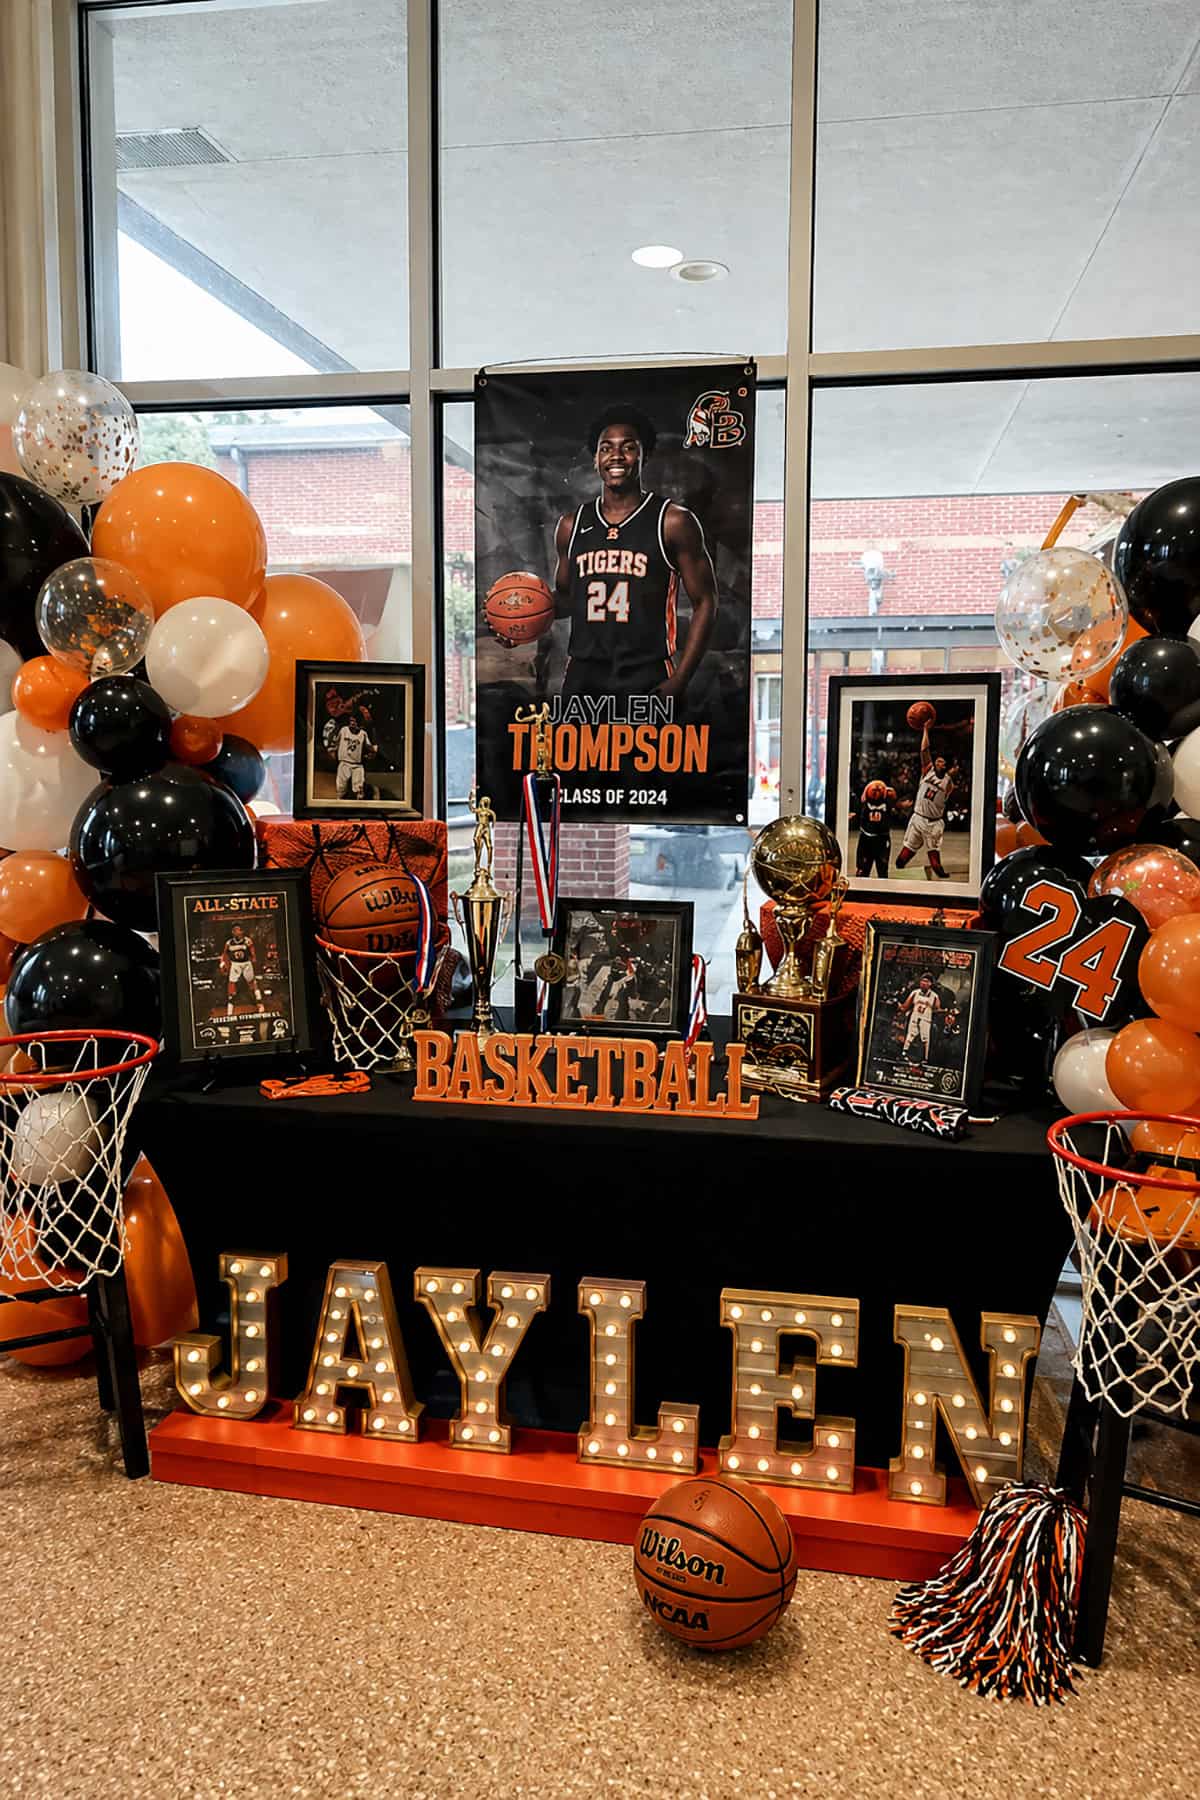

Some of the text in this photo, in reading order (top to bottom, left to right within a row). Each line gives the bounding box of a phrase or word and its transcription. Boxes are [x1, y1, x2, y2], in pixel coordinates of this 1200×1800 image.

[576, 549, 648, 578] TIGERS
[587, 580, 630, 622] 24
[546, 695, 674, 725] JAYLEN
[507, 723, 710, 773] THOMPSON
[606, 789, 625, 804] OF
[629, 789, 668, 805] 2024
[192, 896, 280, 913] ALL-STATE
[1000, 879, 1136, 1021] 24
[413, 1030, 760, 1116] BASKETBALL
[173, 1252, 1041, 1510] JAYLEN
[639, 1527, 726, 1586] Wilson
[643, 1588, 710, 1632] NCAA
